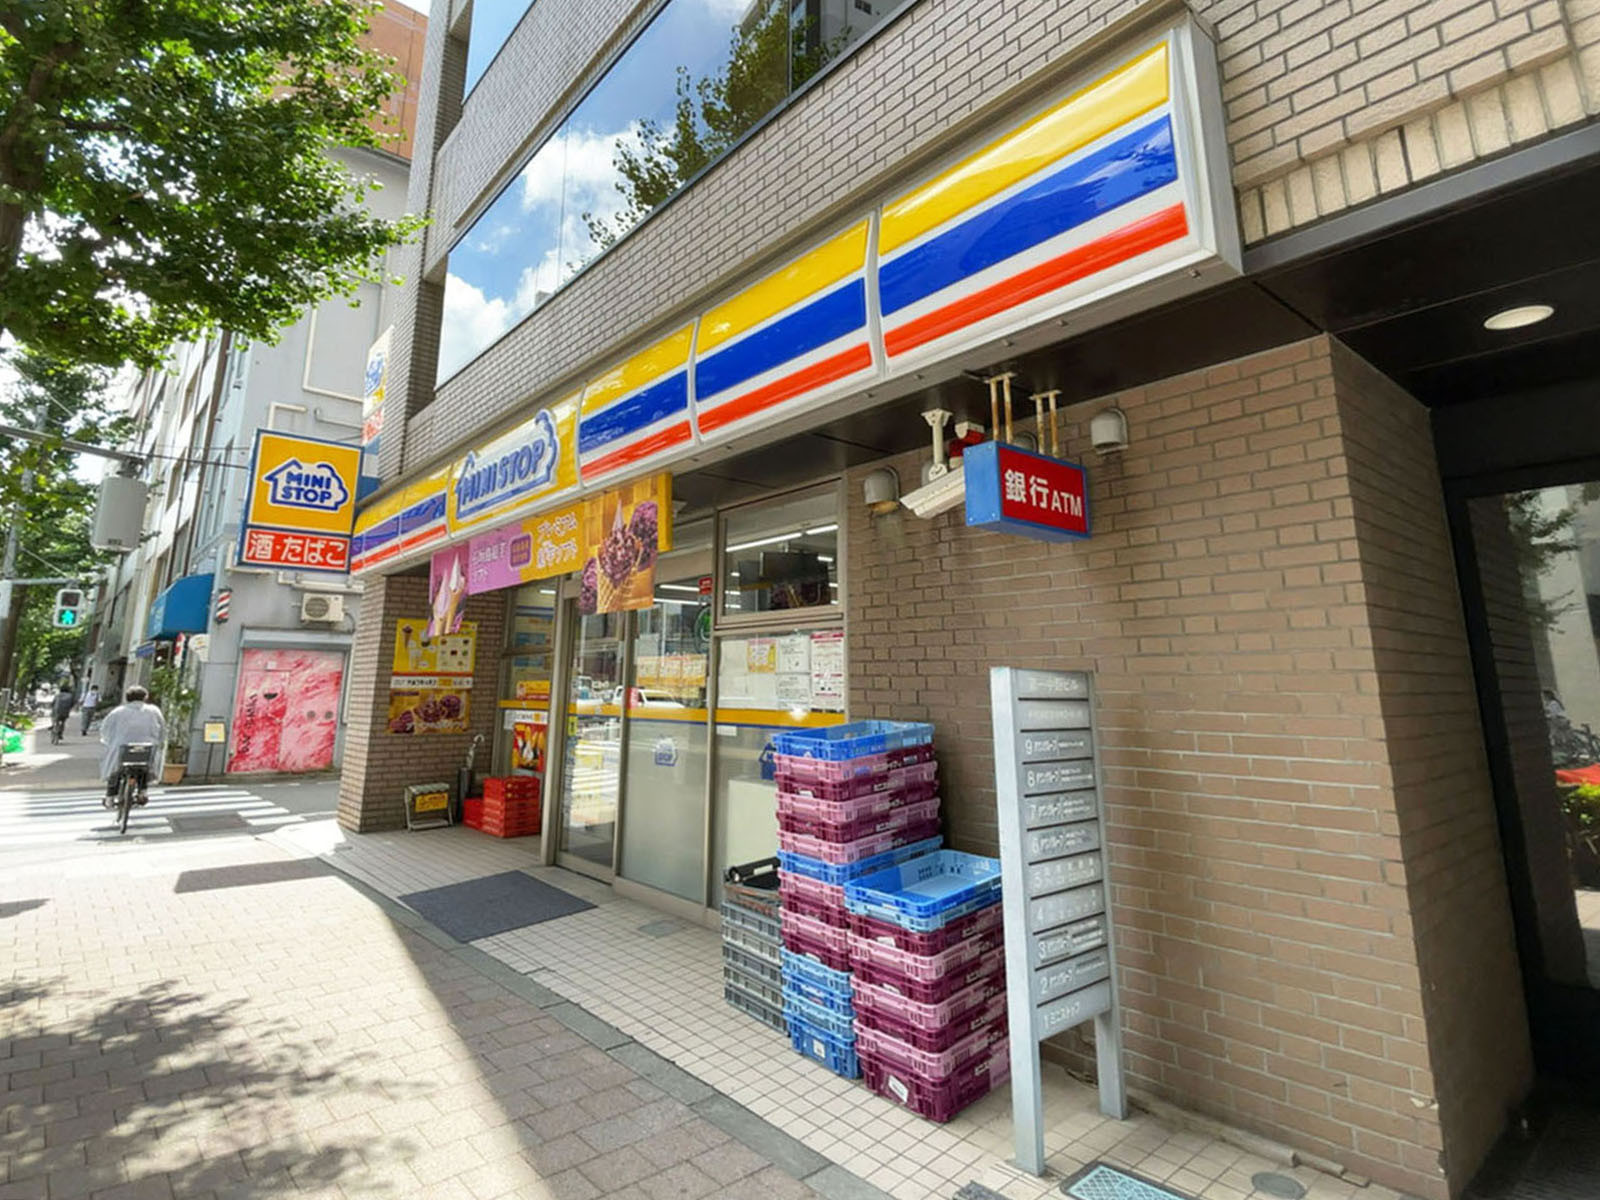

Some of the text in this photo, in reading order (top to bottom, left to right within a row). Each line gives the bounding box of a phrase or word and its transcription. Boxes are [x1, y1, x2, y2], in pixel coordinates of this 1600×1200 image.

[498, 438, 545, 489] STOP
[286, 471, 331, 490] MINI
[281, 485, 332, 503] STOP
[1004, 469, 1083, 518] 銀行ATM
[1025, 738, 1033, 755] 9
[1027, 770, 1036, 788] 8
[1038, 940, 1046, 959] 3
[1040, 976, 1048, 995] 2
